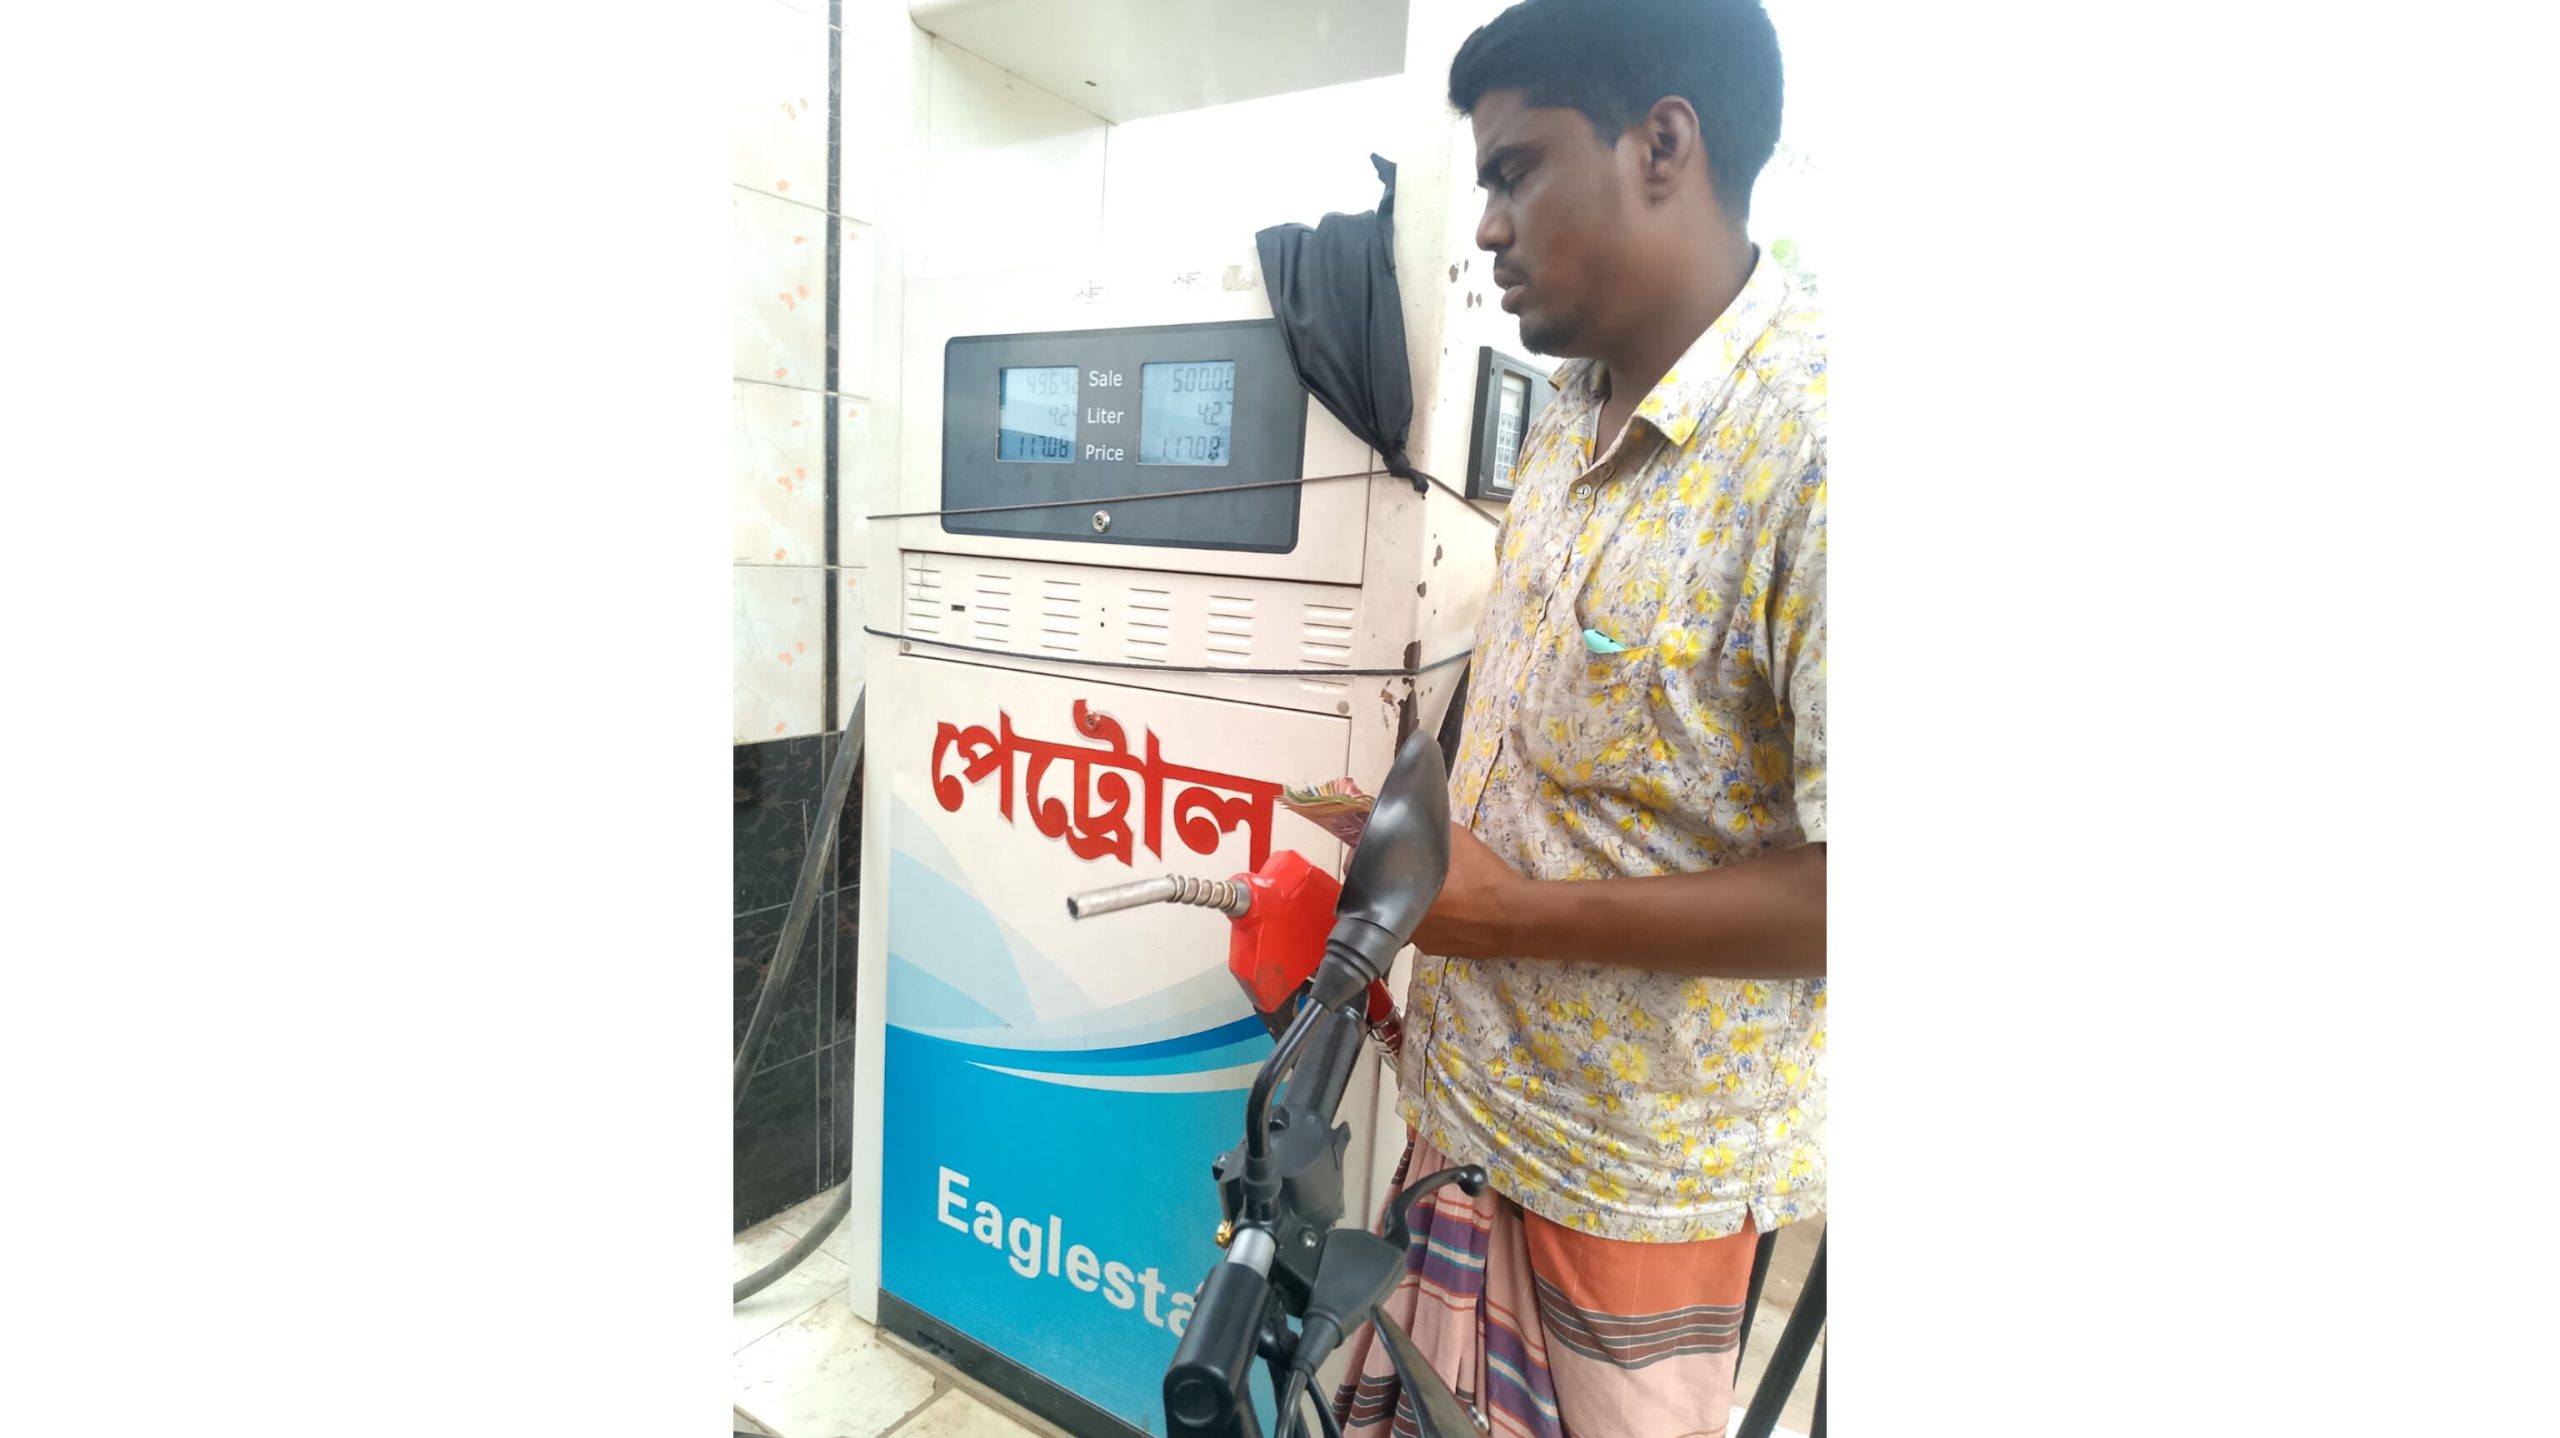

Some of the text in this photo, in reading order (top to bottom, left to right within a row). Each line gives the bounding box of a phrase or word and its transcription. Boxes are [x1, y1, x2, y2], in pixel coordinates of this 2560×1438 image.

[1089, 370, 1123, 387] Sale
[1087, 407, 1125, 424] Liter
[1198, 401, 1232, 426] 4.2
[1085, 444, 1124, 461] Price
[931, 699, 1284, 873] পেট্রোল
[938, 1166, 1198, 1338] Eaglesta
